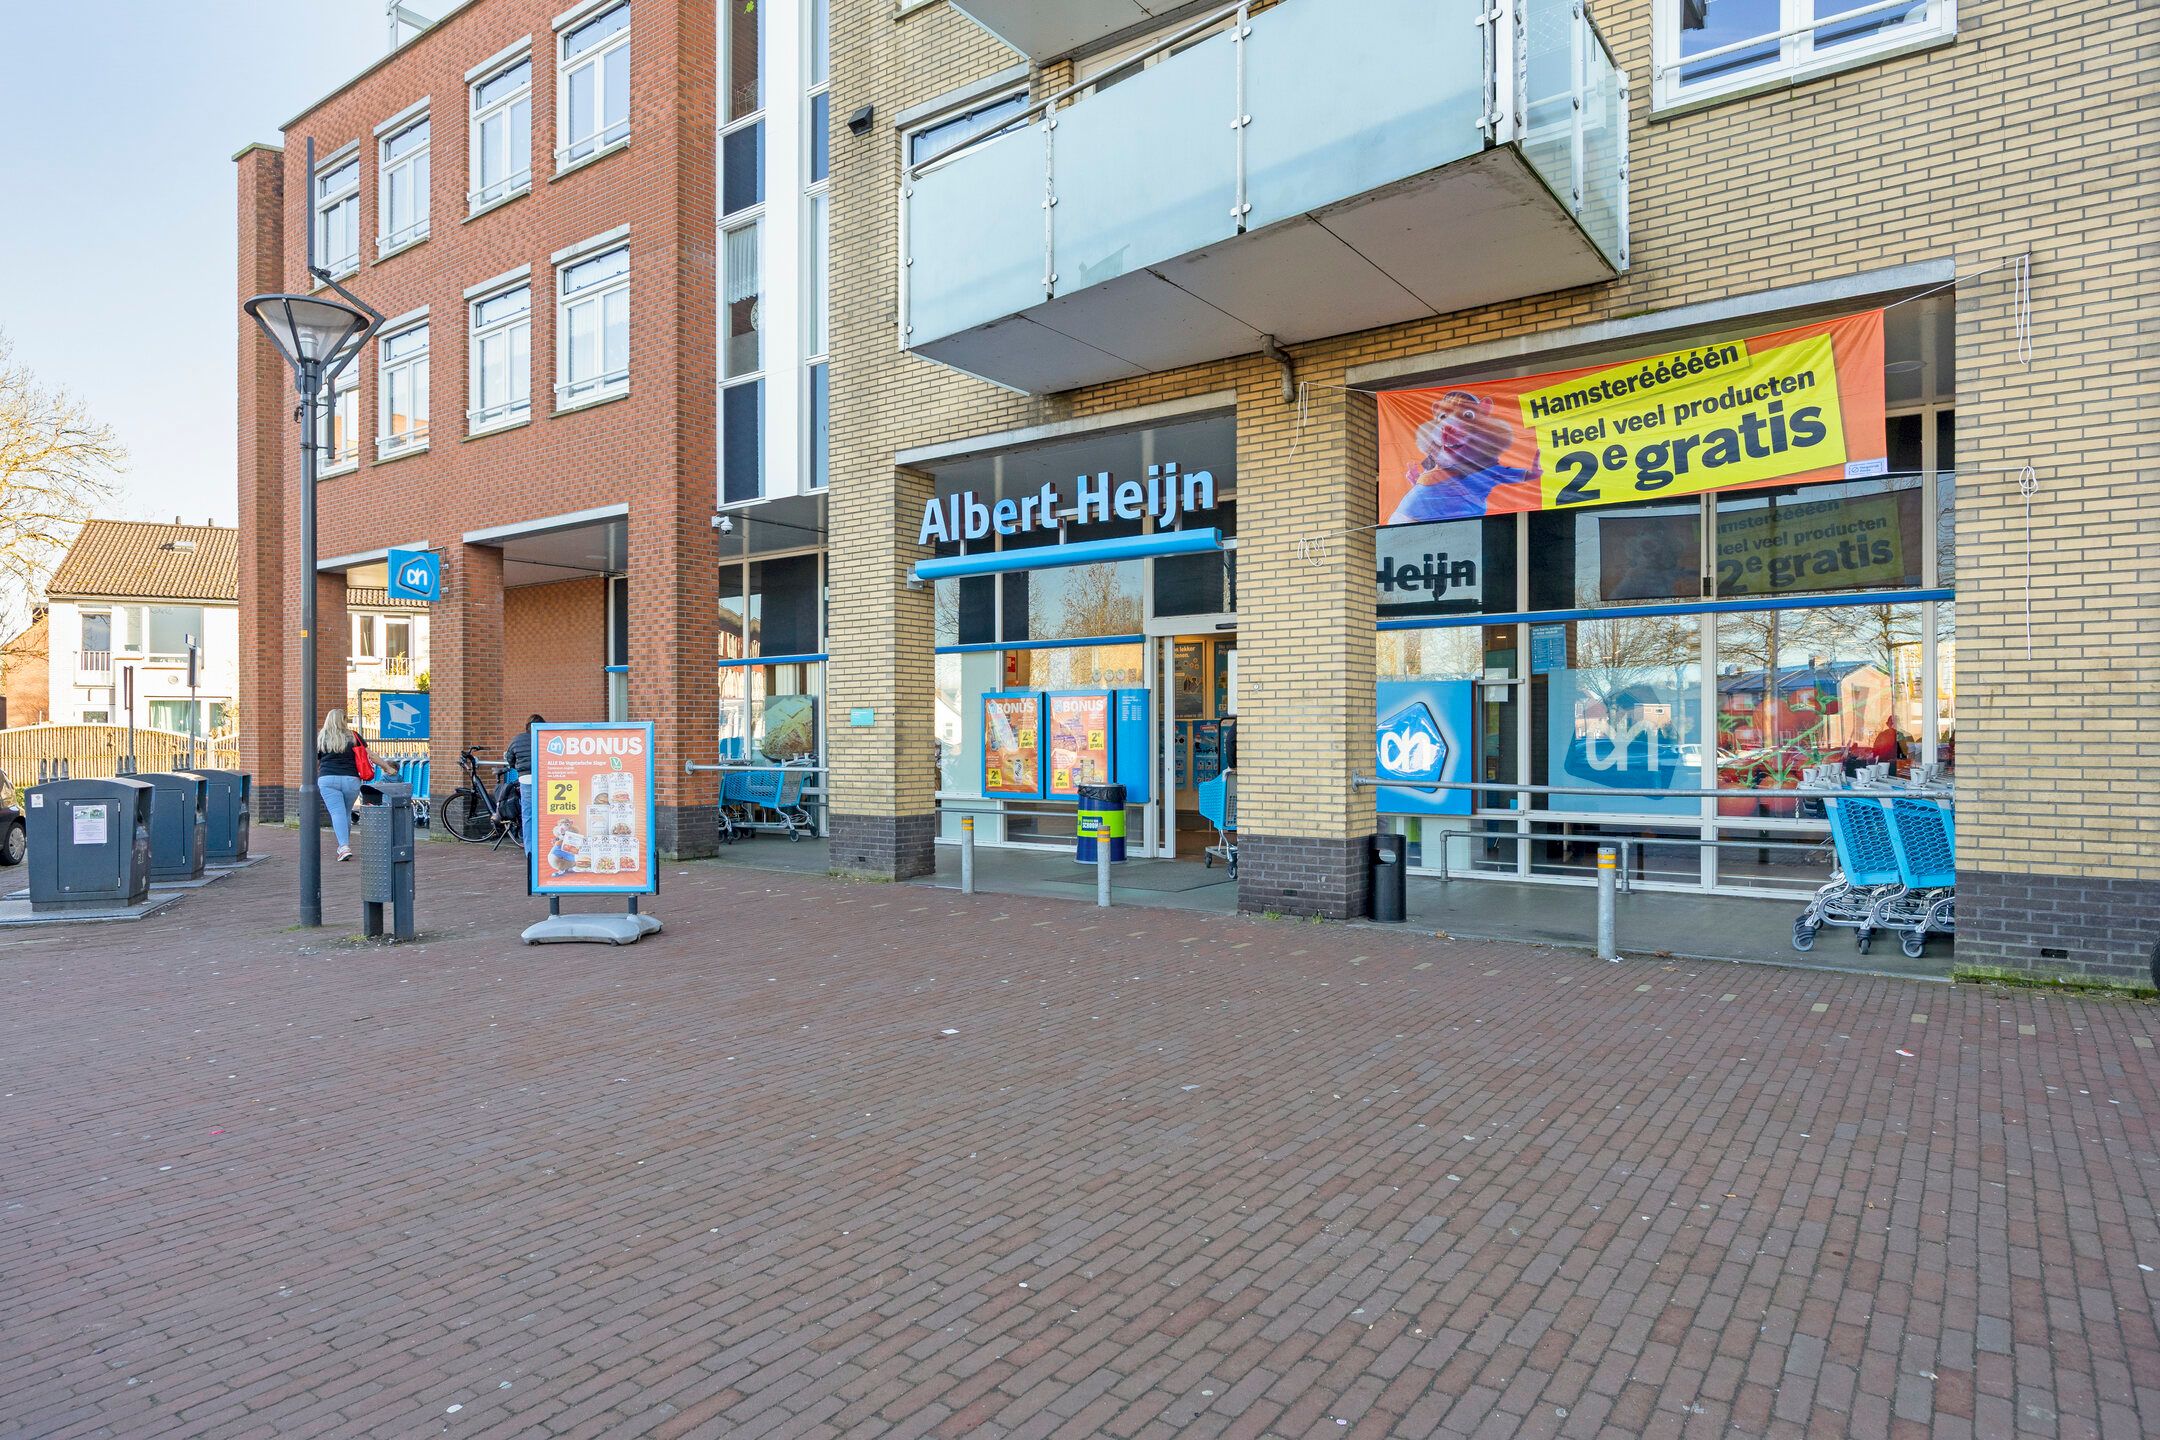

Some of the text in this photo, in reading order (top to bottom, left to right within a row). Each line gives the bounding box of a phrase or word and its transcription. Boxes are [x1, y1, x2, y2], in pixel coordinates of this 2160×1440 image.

[1551, 370, 1815, 448] Heel veel producten
[1635, 400, 1827, 491] gratis
[918, 462, 1217, 546] Albert Heijn
[1753, 532, 1788, 550] veel
[1794, 515, 1887, 544] producten
[1768, 534, 1893, 588] gratis
[997, 702, 1034, 714] BONUS
[1062, 700, 1104, 712] BONUS
[566, 737, 643, 755] BONUS
[550, 802, 577, 812] gratis
